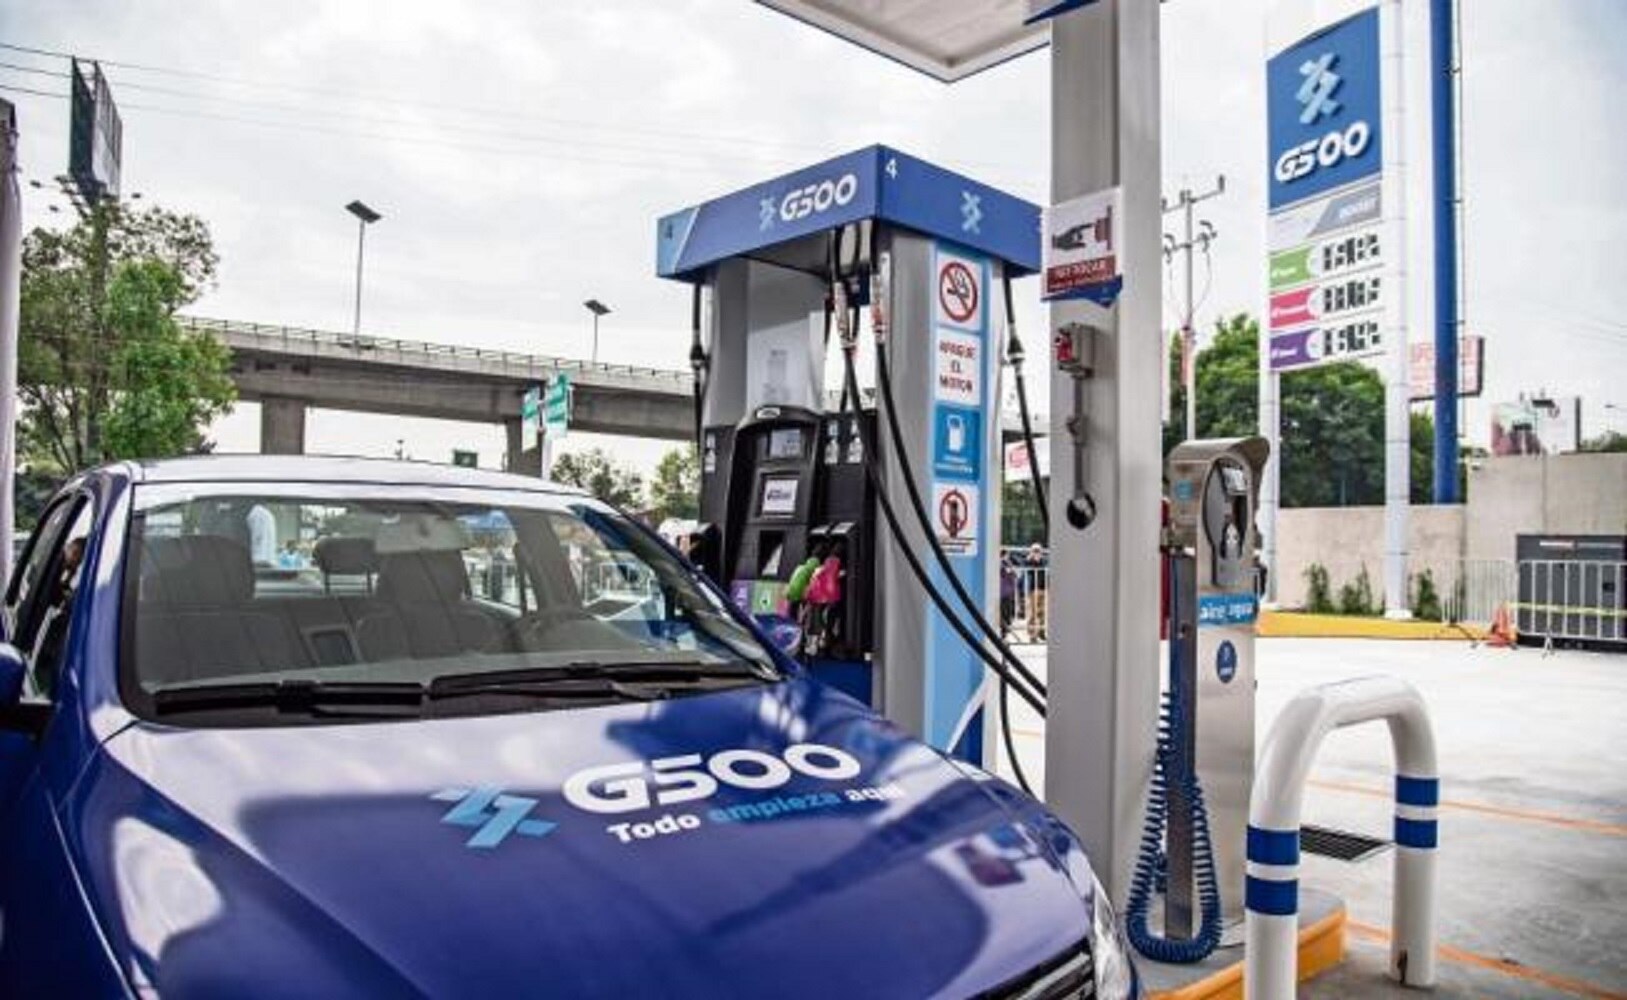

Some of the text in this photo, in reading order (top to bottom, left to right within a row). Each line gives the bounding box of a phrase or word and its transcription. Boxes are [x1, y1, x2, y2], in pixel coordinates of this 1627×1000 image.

[885, 158, 899, 180] 4
[1274, 120, 1371, 182] G500
[780, 173, 858, 221] G500
[563, 743, 861, 813] G500
[606, 813, 701, 844] Todo
[706, 791, 841, 823] empieza
